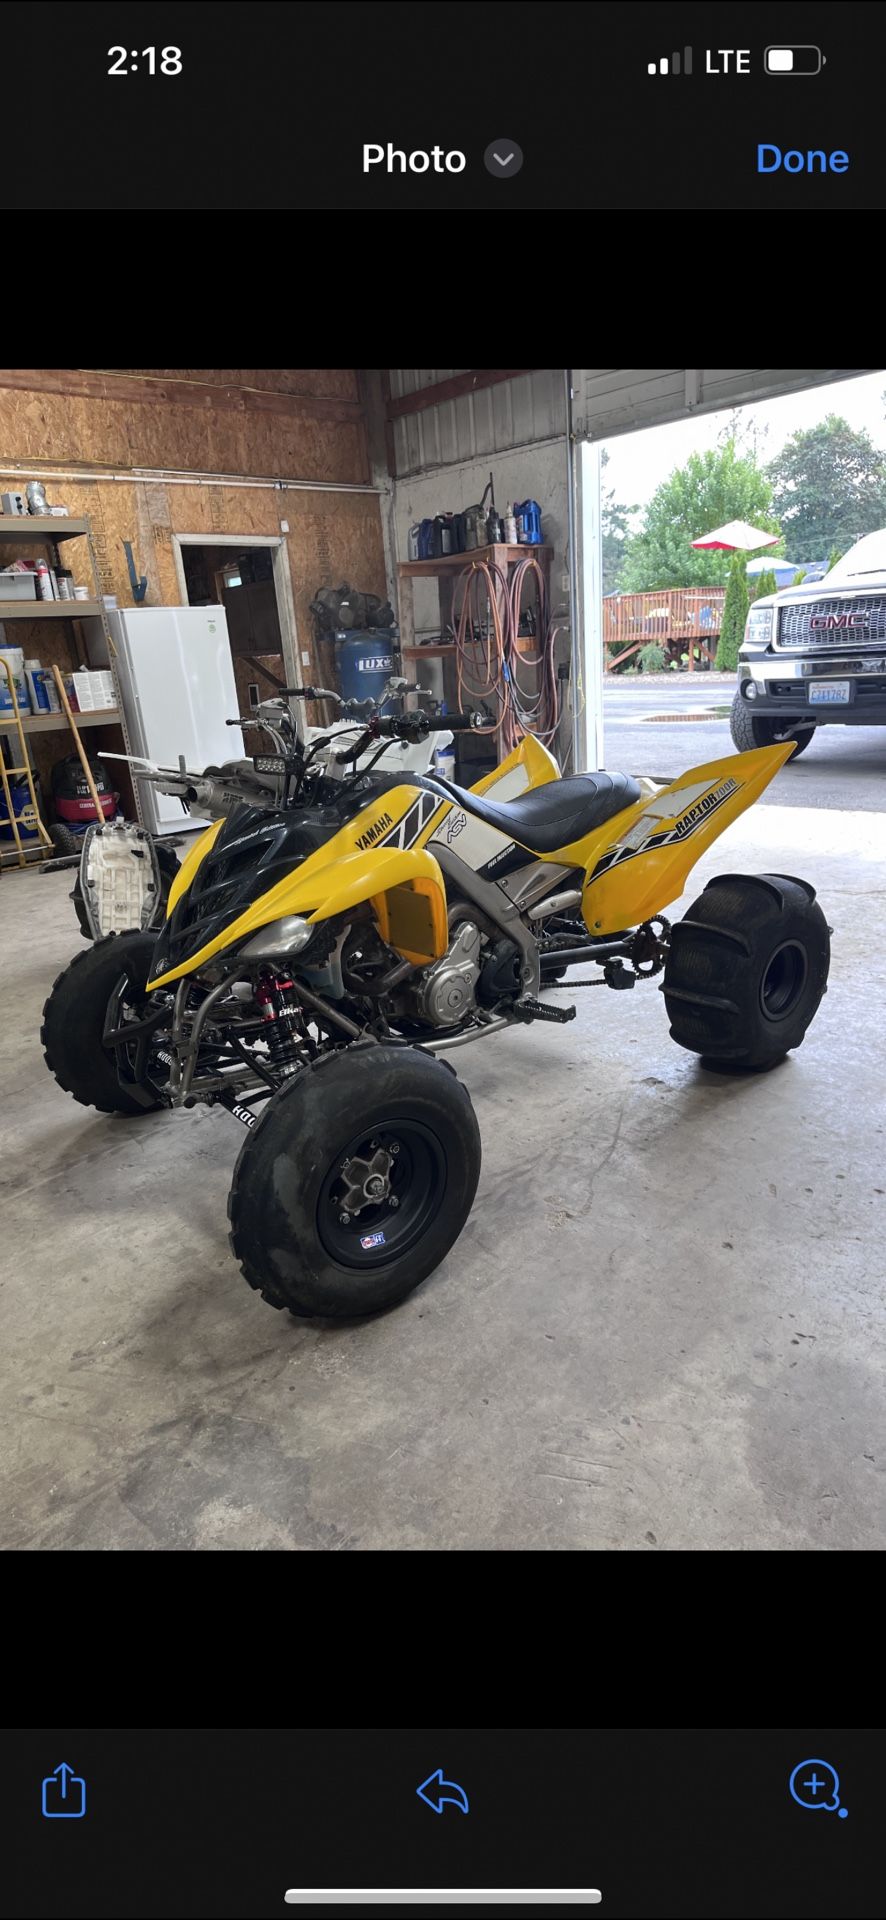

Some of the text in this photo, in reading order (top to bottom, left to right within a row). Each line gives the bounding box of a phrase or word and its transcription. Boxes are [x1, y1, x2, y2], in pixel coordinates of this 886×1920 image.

[108, 46, 183, 76] 2:18
[706, 50, 750, 73] LTE
[362, 143, 467, 174] Photo
[757, 143, 850, 174] Done
[811, 613, 867, 630] GMC
[675, 792, 718, 834] RAPTOR
[715, 778, 737, 798] 700R
[354, 812, 394, 850] YAMAHA
